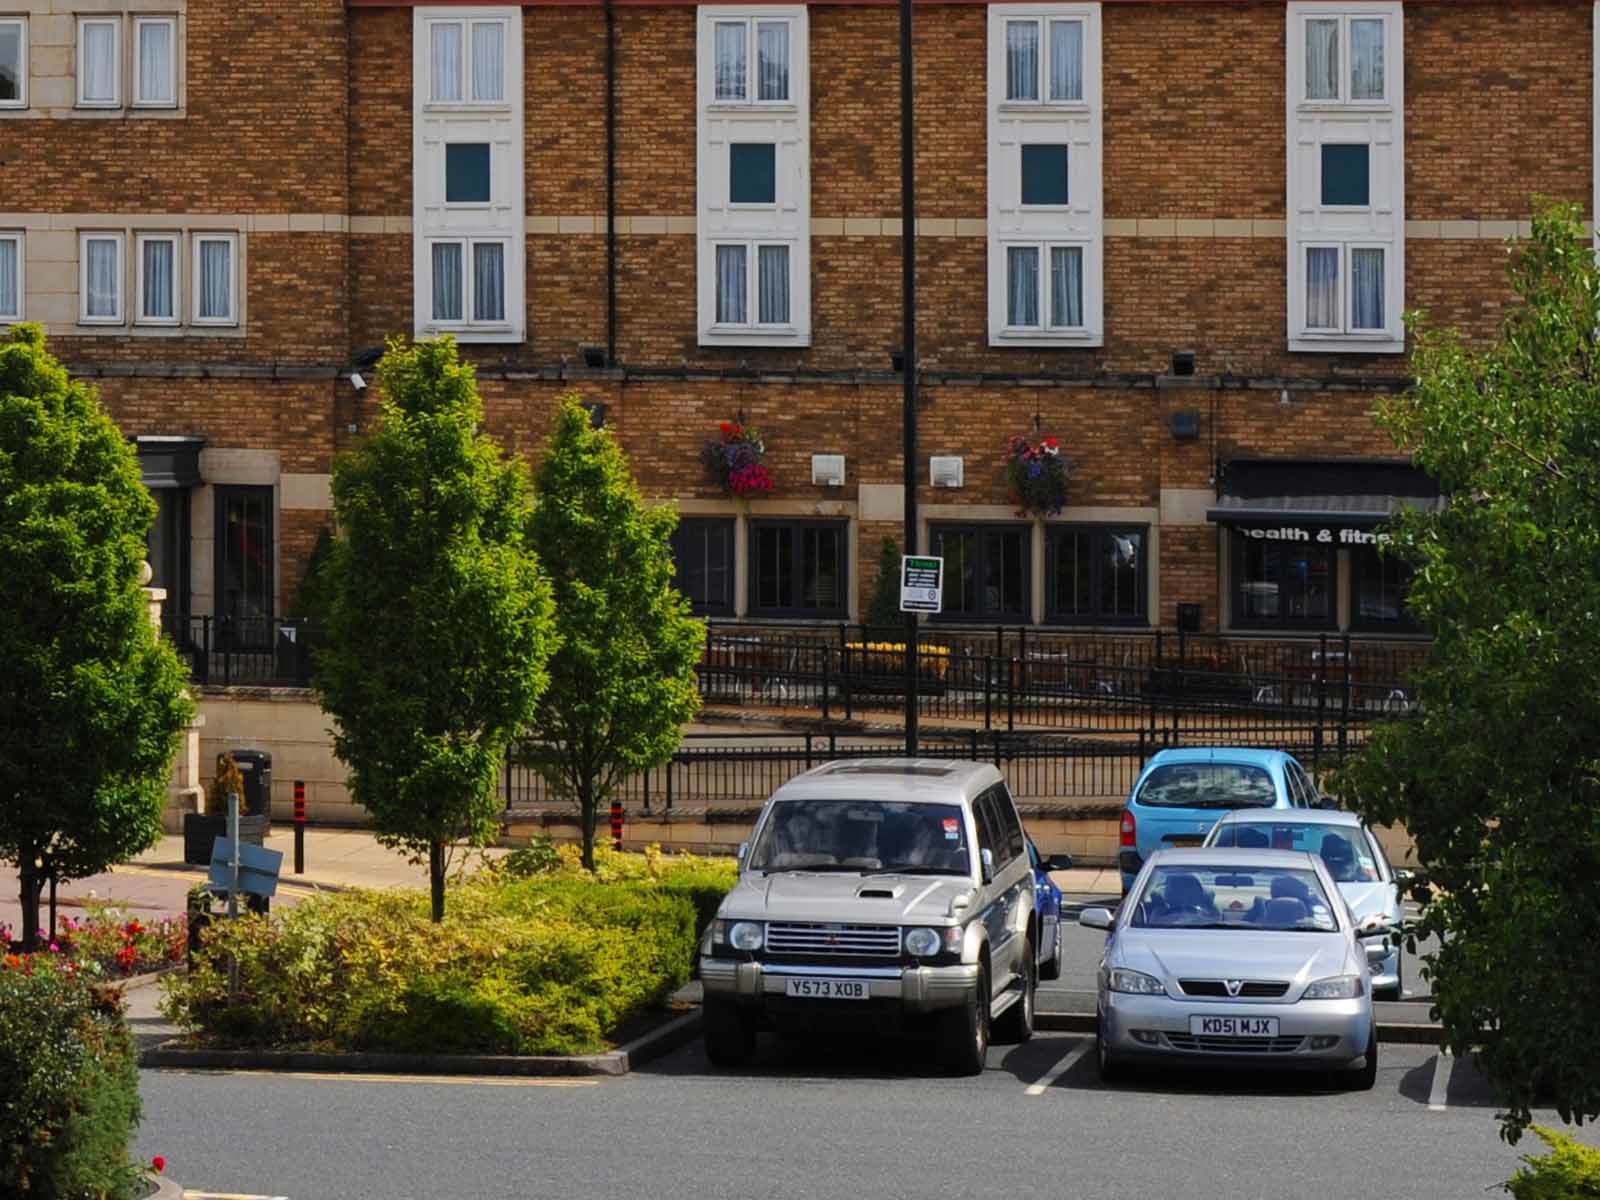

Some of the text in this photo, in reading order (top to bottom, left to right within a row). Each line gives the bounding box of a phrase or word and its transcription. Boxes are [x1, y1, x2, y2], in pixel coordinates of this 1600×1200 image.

[1316, 528, 1333, 543] &
[1339, 528, 1414, 546] fitne
[792, 980, 864, 997] Y573 XOB
[1202, 1018, 1271, 1034] KD51 MJX
